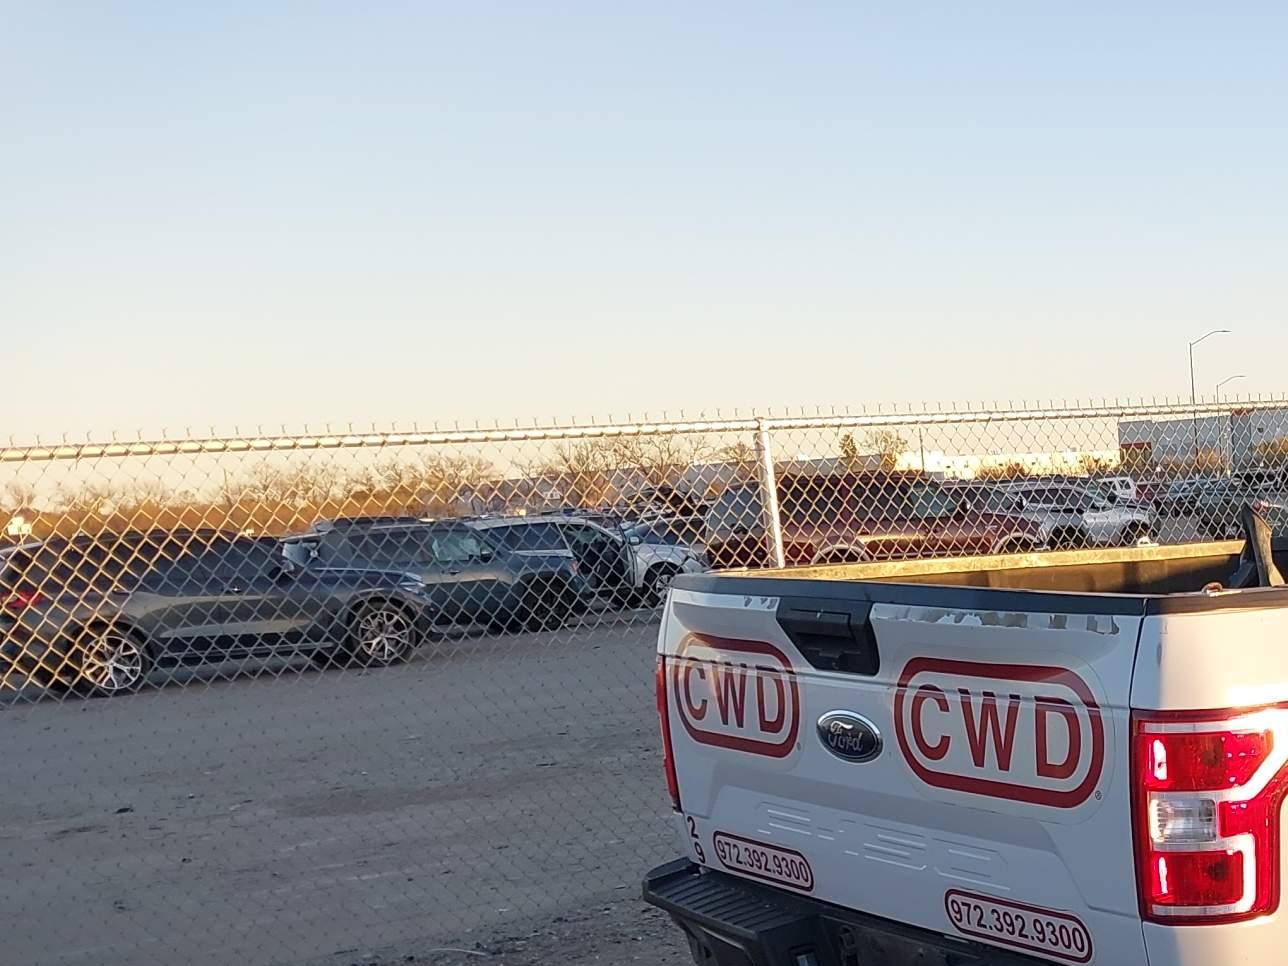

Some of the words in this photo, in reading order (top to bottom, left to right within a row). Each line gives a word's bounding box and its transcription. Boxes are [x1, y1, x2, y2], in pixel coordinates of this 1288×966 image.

[684, 657, 785, 734] CWD
[828, 720, 864, 752] Ford
[911, 683, 1081, 780] CWD
[717, 837, 810, 883] 972.392.9300
[950, 898, 1086, 954] 972.392.9300
